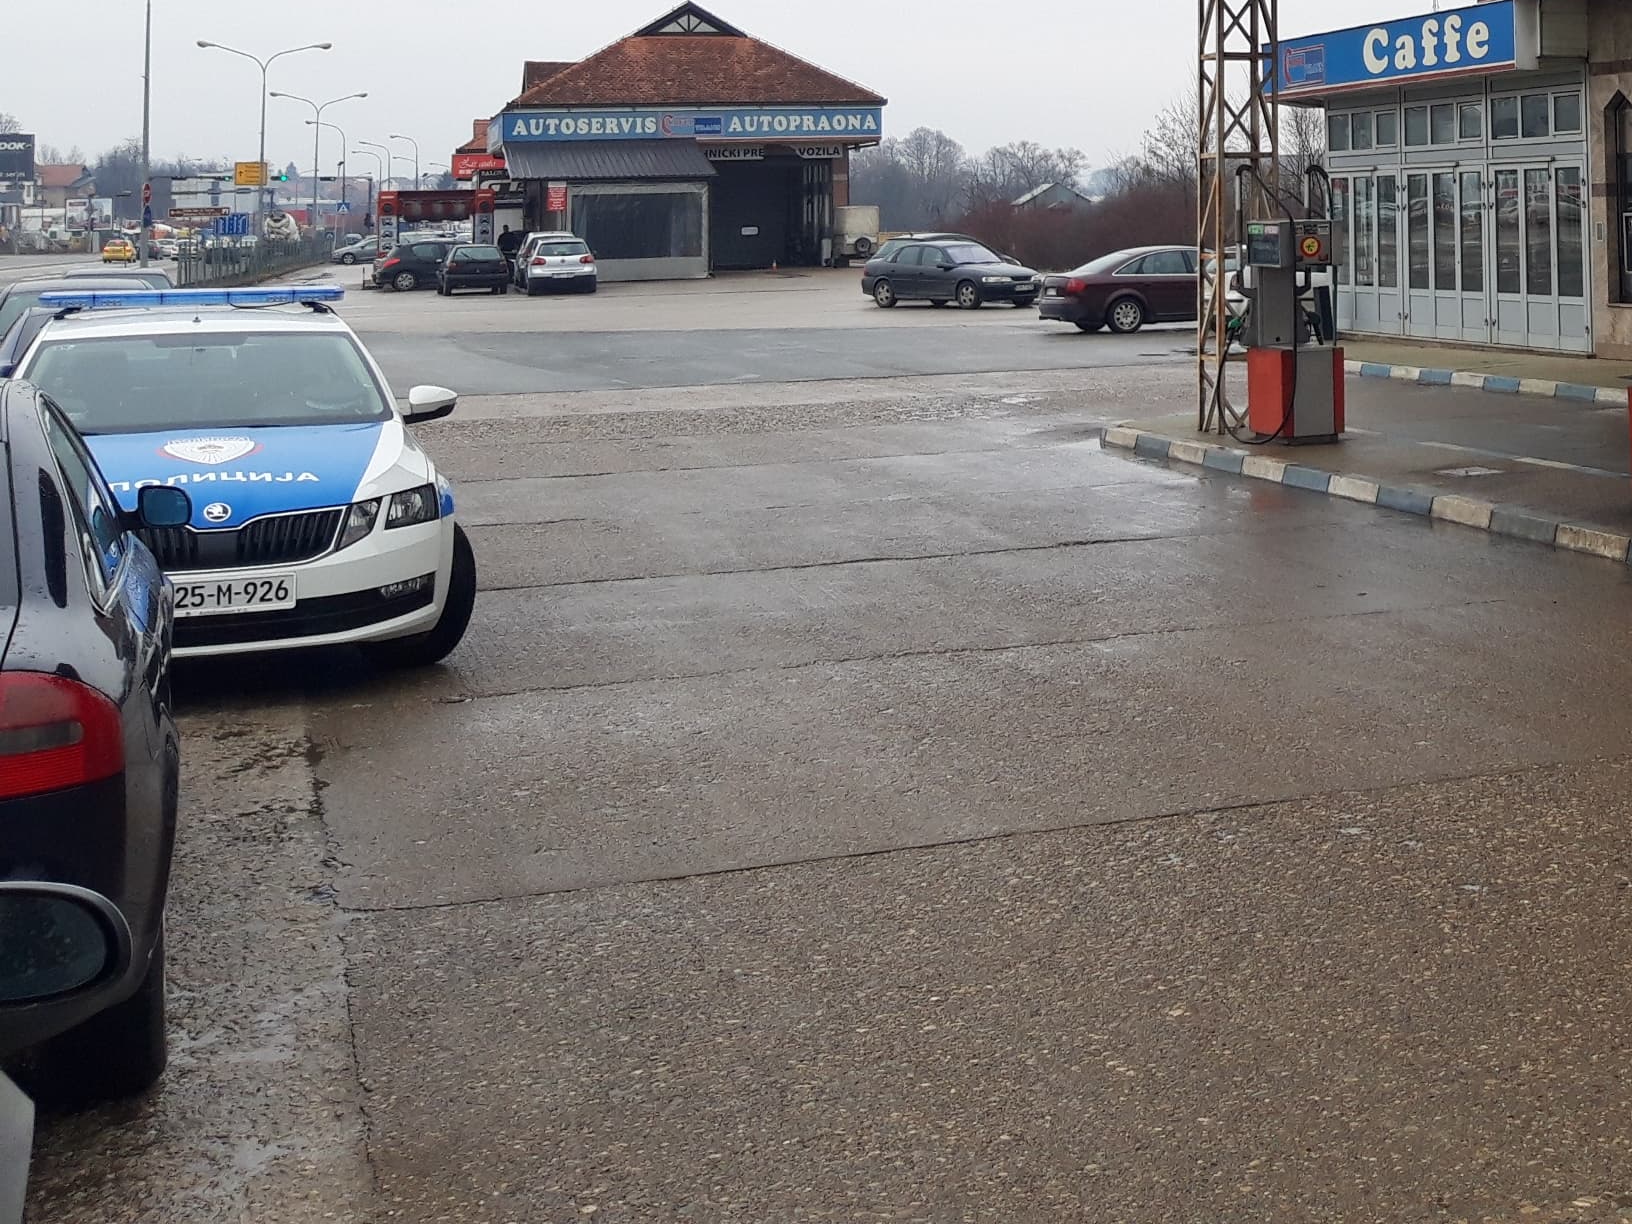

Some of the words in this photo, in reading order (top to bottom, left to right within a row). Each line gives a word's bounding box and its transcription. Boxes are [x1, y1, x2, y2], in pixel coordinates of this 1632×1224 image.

[1363, 14, 1490, 75] Caffe
[512, 115, 657, 136] AUTOSERVIS
[728, 114, 877, 133] AUTOPRAONA
[799, 145, 841, 157] VOZILA
[110, 471, 321, 492] ПОЛИЦИЈА
[174, 579, 290, 610] 25-M-926
